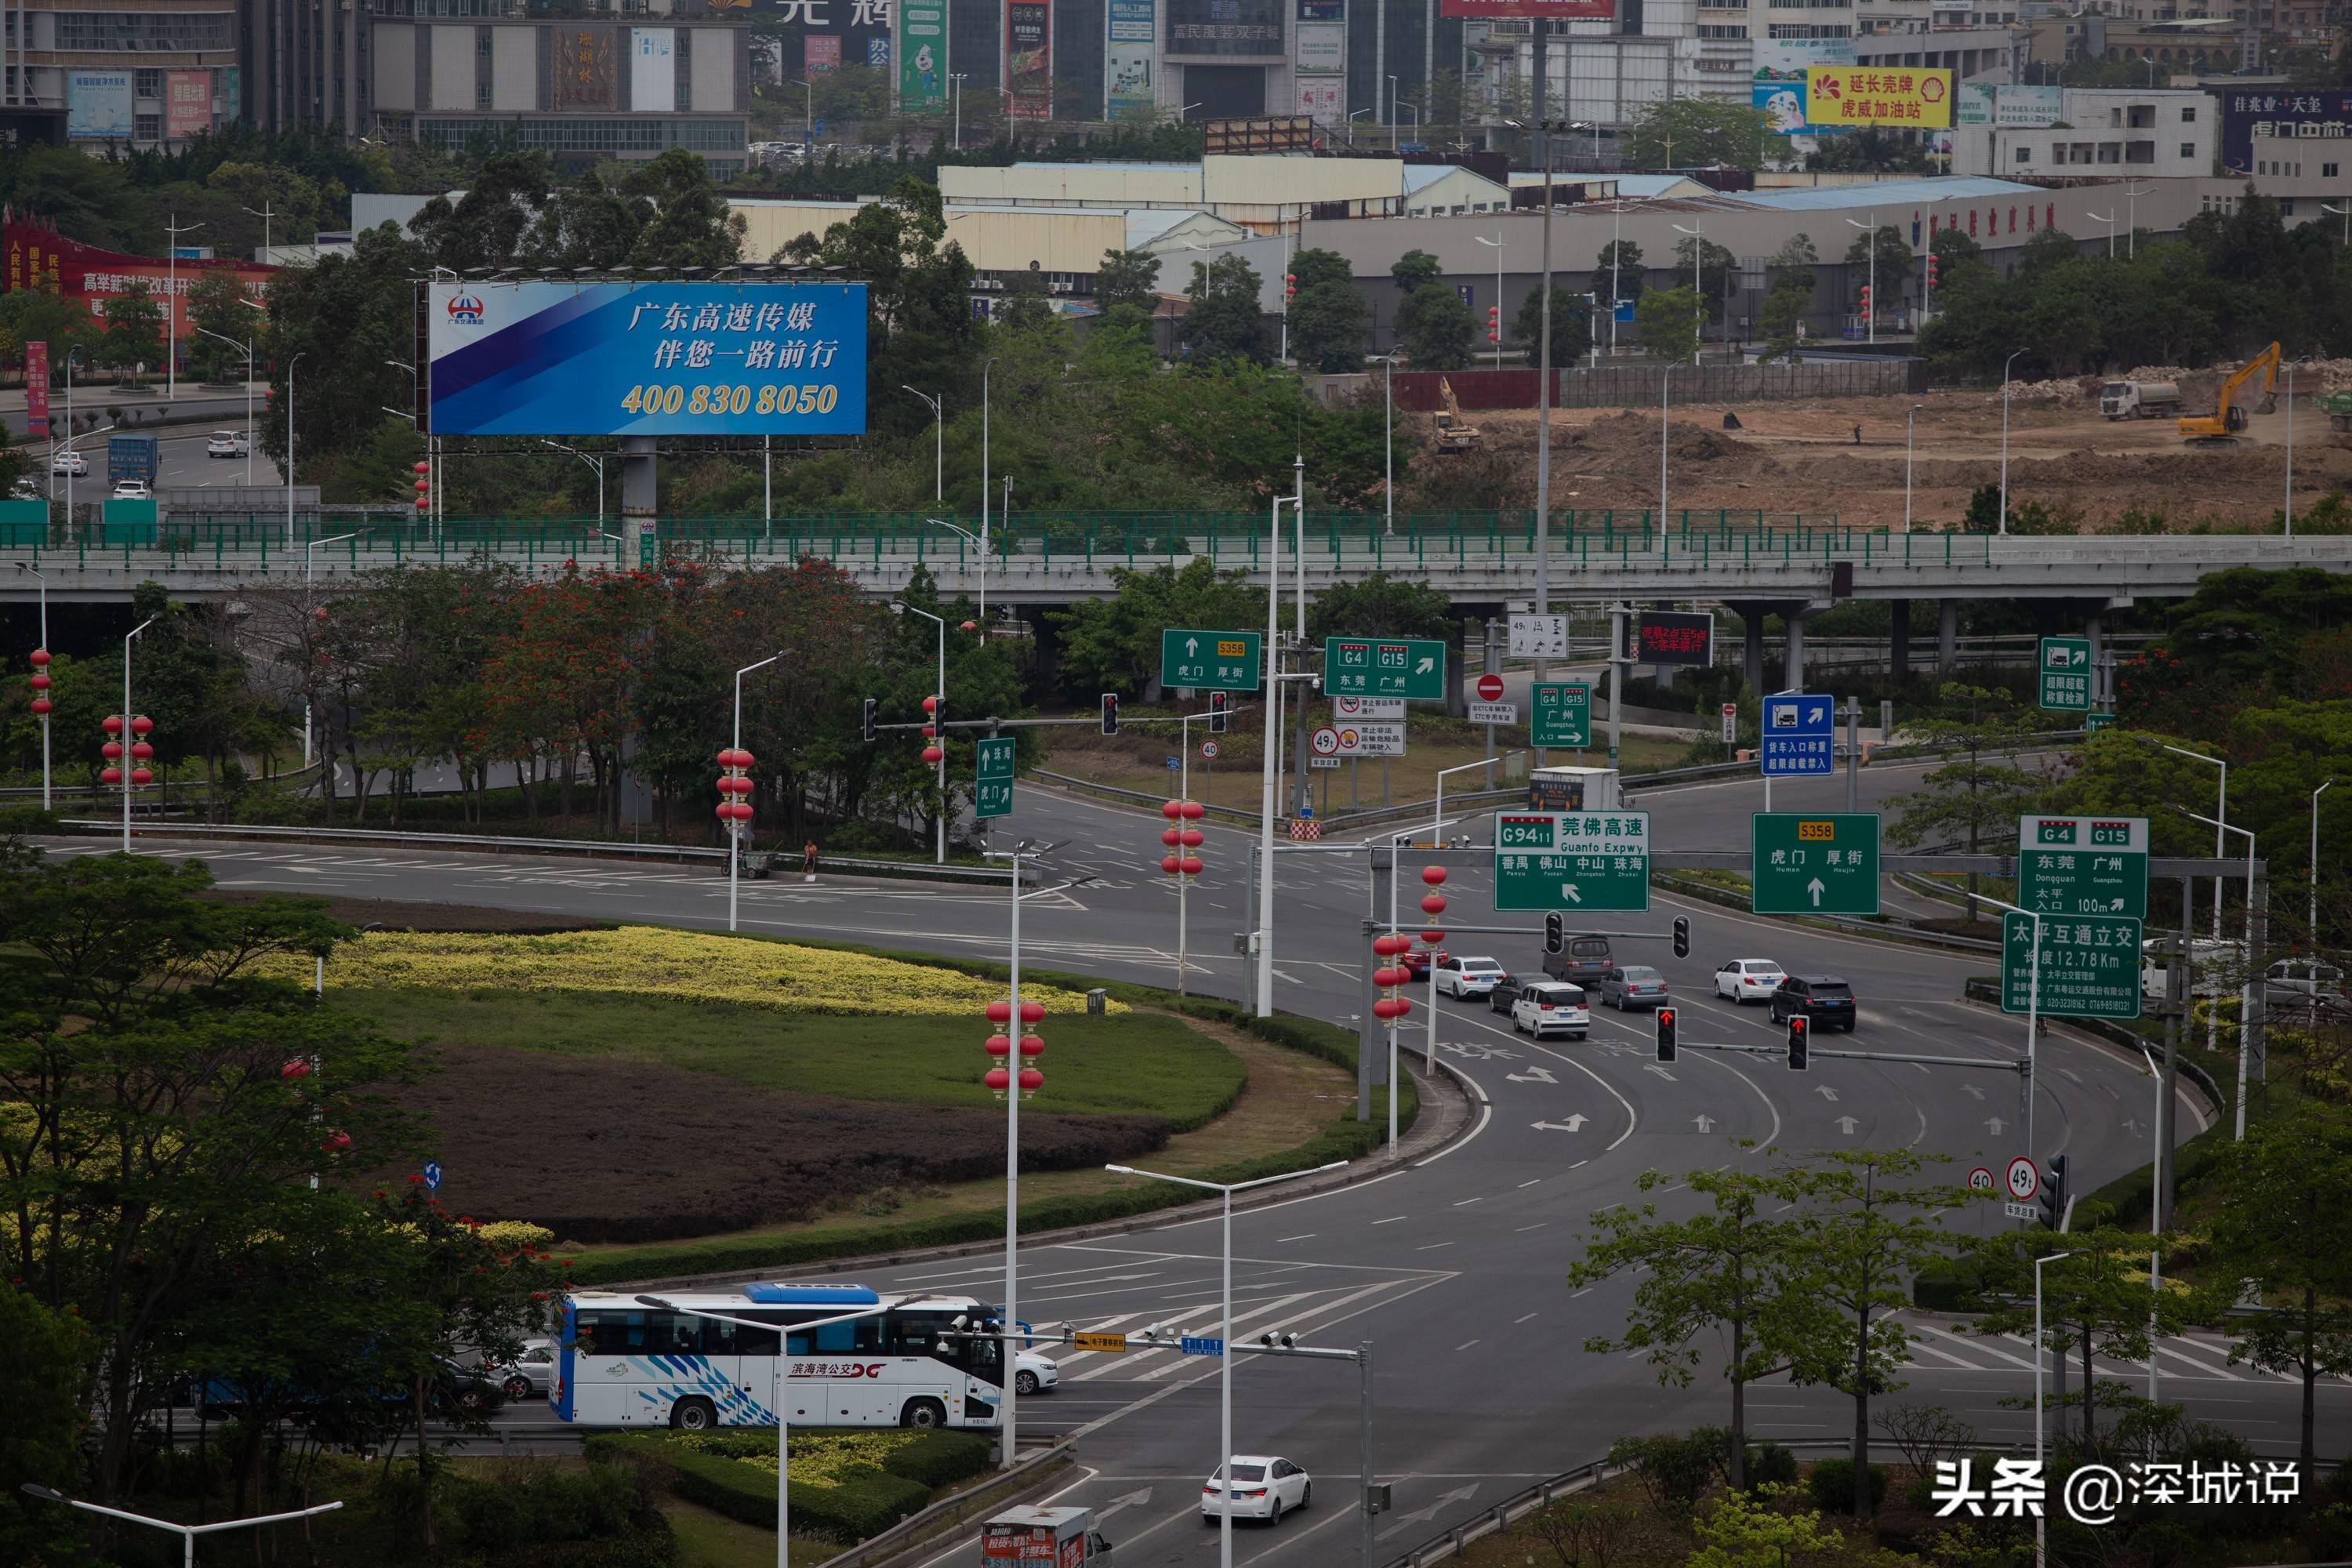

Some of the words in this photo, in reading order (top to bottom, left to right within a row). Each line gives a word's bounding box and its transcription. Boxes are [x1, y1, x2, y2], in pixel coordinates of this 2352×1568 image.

[1173, 24, 1280, 39] 富民服装双子城
[1849, 74, 1914, 94] 延长壳牌
[1842, 100, 1922, 119] 虎威加油站
[628, 301, 817, 332] 广东高速传媒
[654, 339, 840, 369] 伴您一路前行
[621, 384, 684, 415] 400
[688, 384, 750, 415] 830
[755, 383, 838, 415] 8050
[1218, 644, 1244, 654] S358
[1647, 639, 1703, 652] 大客车禁行
[1345, 651, 1363, 664] G4
[1381, 652, 1405, 666] G15
[1178, 665, 1204, 676] 虎门
[1218, 666, 1244, 678] 厚街
[1340, 674, 1366, 686] 东莞
[1379, 676, 1406, 688] 广州
[2046, 675, 2085, 690] 超限超载
[1542, 695, 1556, 703] G4
[1566, 695, 1584, 703] G15
[2045, 690, 2085, 706] 称重检测
[1547, 710, 1573, 720] 广州
[1316, 735, 1334, 748] 49t
[1769, 741, 1826, 753] 货车入口称重
[994, 746, 1011, 760] 珠海
[1204, 745, 1216, 753] 40
[1769, 757, 1826, 769] 超限超载禁入
[981, 785, 999, 800] 虎门
[1562, 817, 1642, 836] 莞佛高速
[1801, 825, 1831, 837] S358
[1503, 827, 1550, 843] G9411
[2045, 829, 2070, 840] G4
[2095, 830, 2126, 842] G15
[1561, 843, 1599, 853] Guanfo
[1605, 843, 1643, 855] Expwy
[1501, 855, 1528, 869] 番禺
[1539, 855, 1567, 869] 佛山
[1577, 856, 1605, 869] 中山
[1613, 856, 1643, 871] 珠海
[1770, 849, 1806, 865] 虎门
[1826, 850, 1863, 866] 厚街
[2037, 855, 2075, 869] 东莞
[2092, 856, 2122, 871] 广州
[2035, 874, 2076, 884] Dongguan
[2035, 888, 2063, 898] 太平
[2035, 901, 2063, 910] 入口
[2078, 898, 2107, 913] 100m
[2012, 920, 2132, 947] 太平互通立交
[2047, 970, 2096, 980] 太平立交管理部
[2046, 984, 2132, 997] 广东粤运交通股份有限公司
[1973, 1174, 1989, 1188] 40
[2013, 1168, 2032, 1189] 49t
[2007, 1204, 2036, 1218] 车货总重
[791, 1363, 852, 1374] 滨海湾公交
